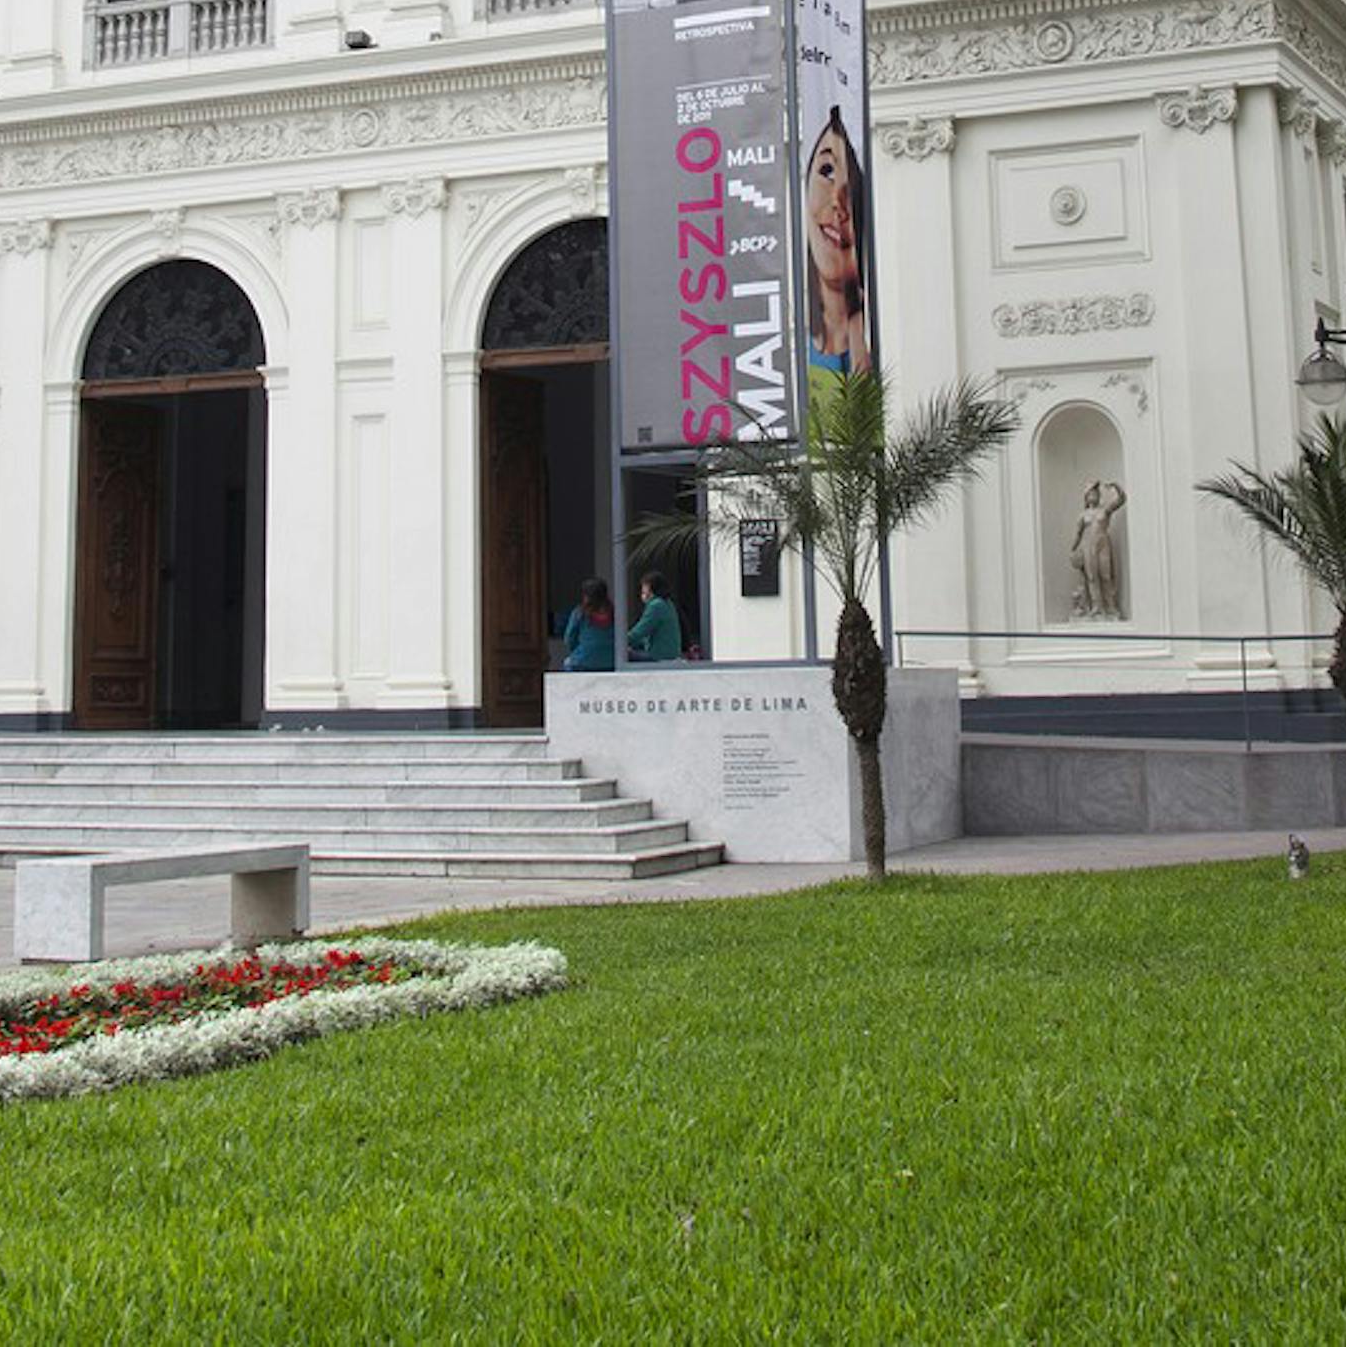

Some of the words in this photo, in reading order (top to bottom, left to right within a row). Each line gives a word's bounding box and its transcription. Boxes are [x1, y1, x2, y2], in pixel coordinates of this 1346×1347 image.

[675, 20, 755, 42] RETROSPECTIVA
[720, 84, 749, 98] JULIO
[751, 81, 765, 94] AL
[700, 95, 745, 110] OCTUBRE
[727, 145, 775, 168] MALI
[740, 236, 767, 254] BCP
[675, 127, 734, 447] SZYSZLO
[732, 280, 788, 443] MALI
[579, 700, 638, 713] MUSEO
[646, 700, 668, 713] DE
[676, 699, 722, 713] ARTE
[730, 698, 753, 711] DE
[762, 697, 808, 711] LIMA
